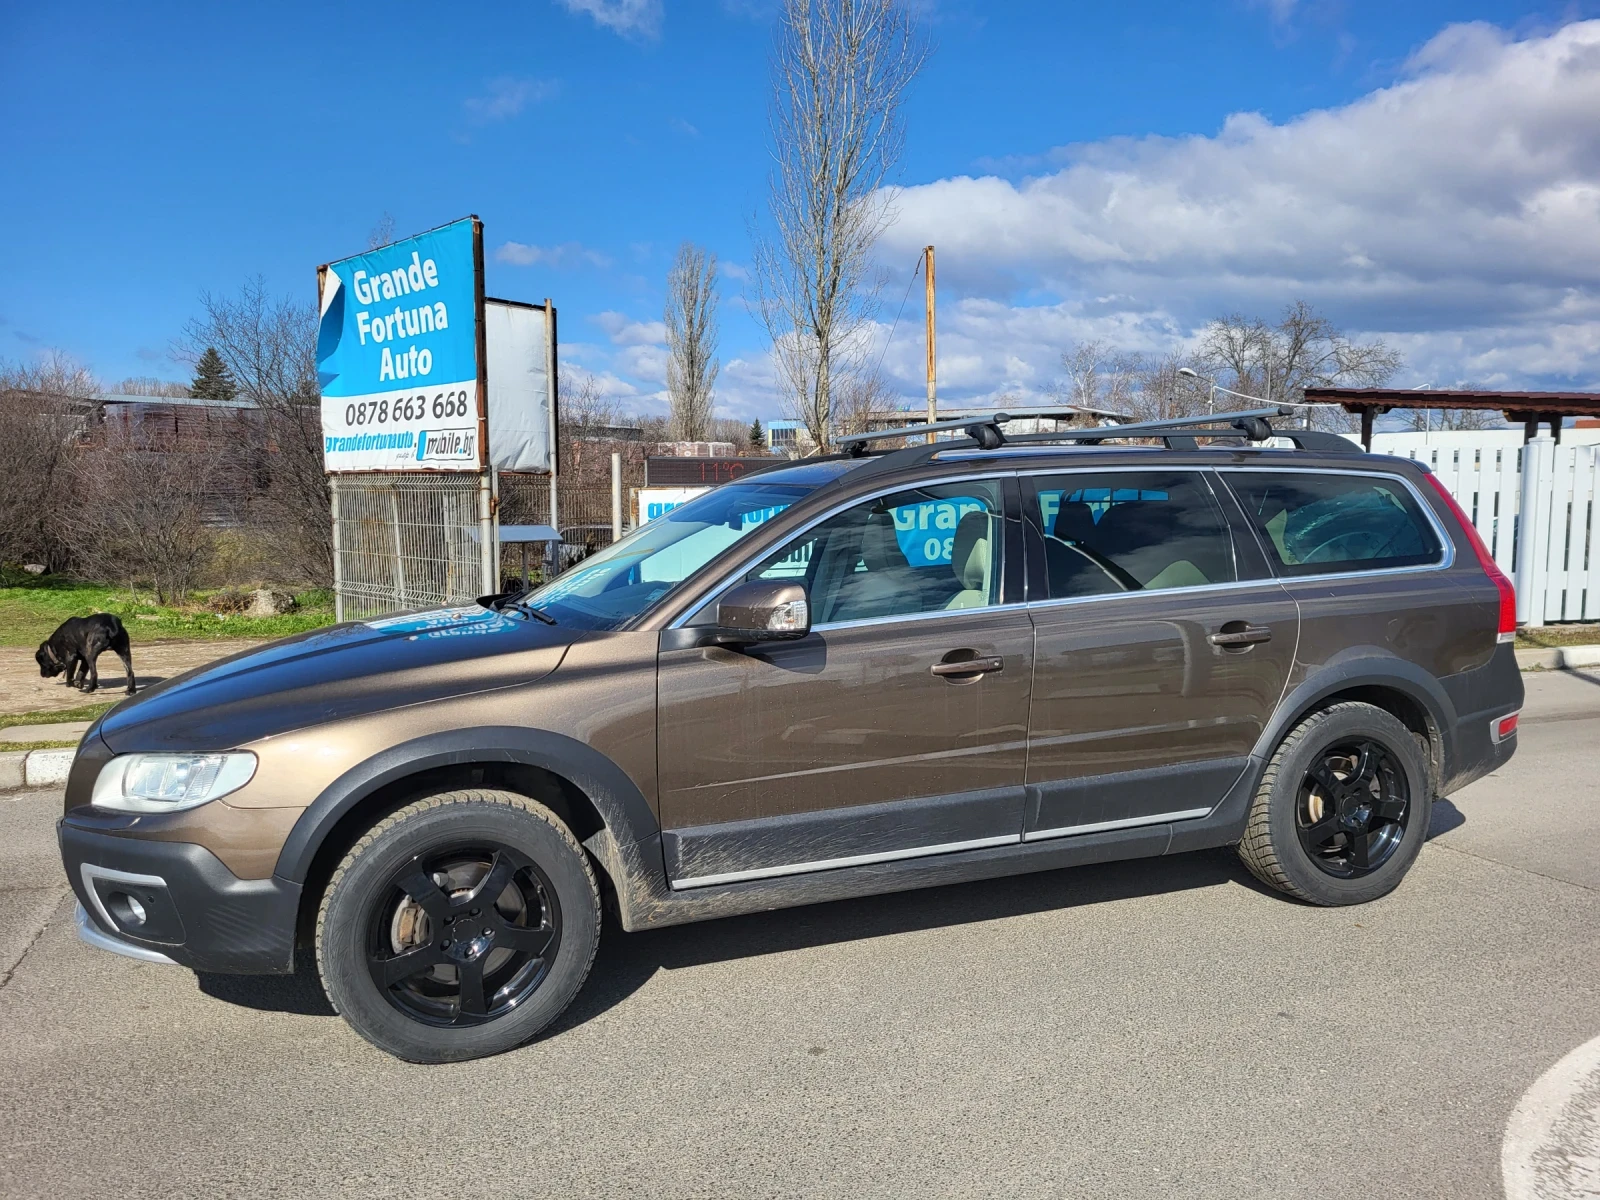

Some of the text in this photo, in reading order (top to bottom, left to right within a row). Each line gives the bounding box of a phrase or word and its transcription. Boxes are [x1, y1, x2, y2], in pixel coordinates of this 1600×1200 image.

[353, 251, 439, 305] Grande
[356, 301, 449, 345] Fortuna
[379, 345, 433, 382] Auto
[345, 389, 467, 426] 0878 663 668
